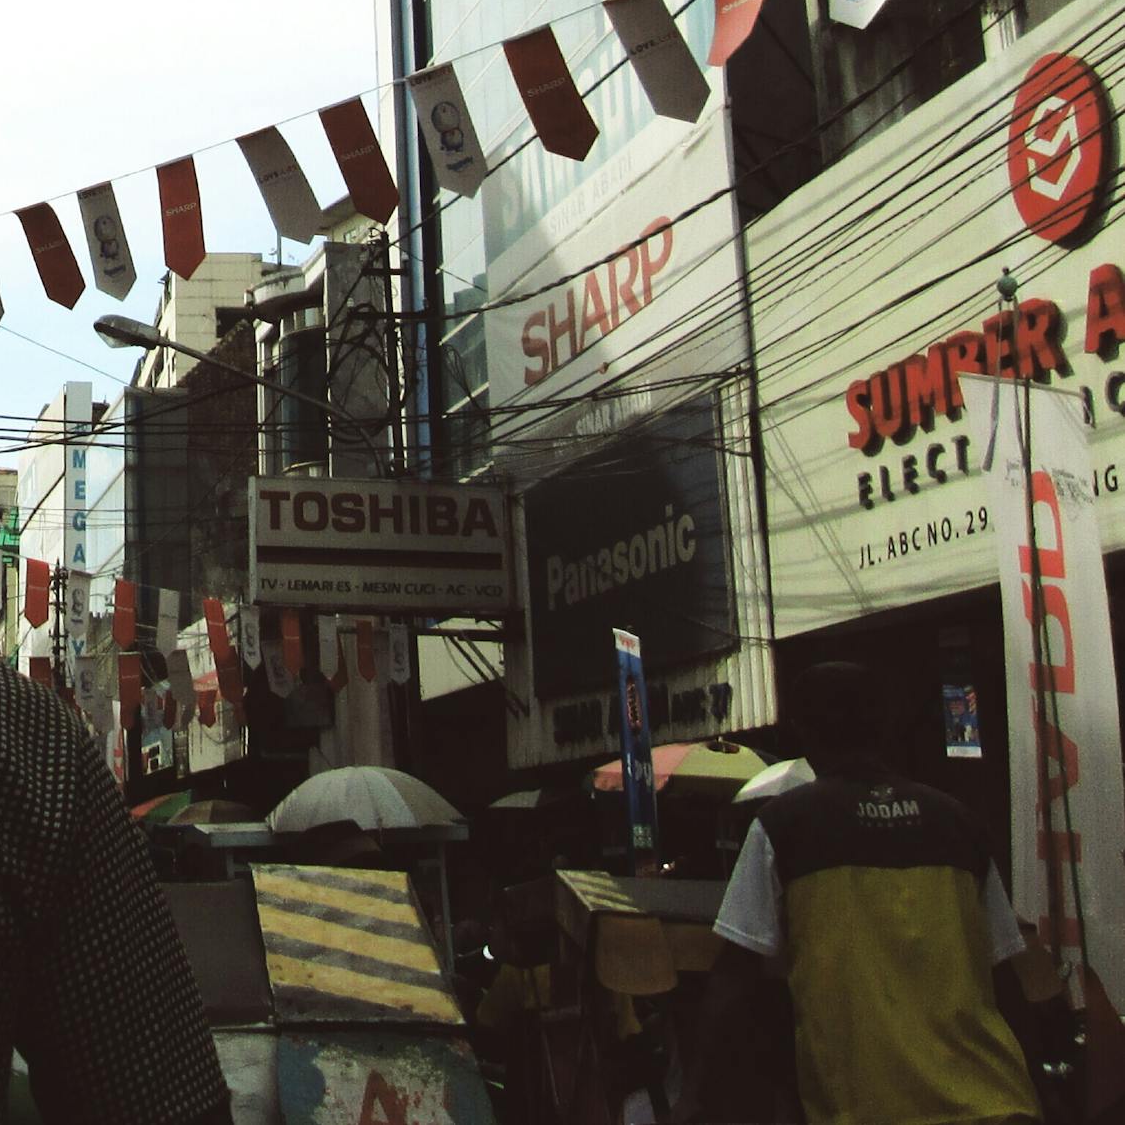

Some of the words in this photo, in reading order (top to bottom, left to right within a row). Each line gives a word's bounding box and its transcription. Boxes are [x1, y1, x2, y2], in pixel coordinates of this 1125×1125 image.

[521, 216, 673, 387] SHARP
[260, 490, 497, 537] TOSHIBA
[261, 579, 277, 590] TV
[362, 582, 401, 594] MESIN
[404, 584, 436, 596] CUCI
[446, 584, 466, 596] AC
[546, 504, 696, 612] Panasonic
